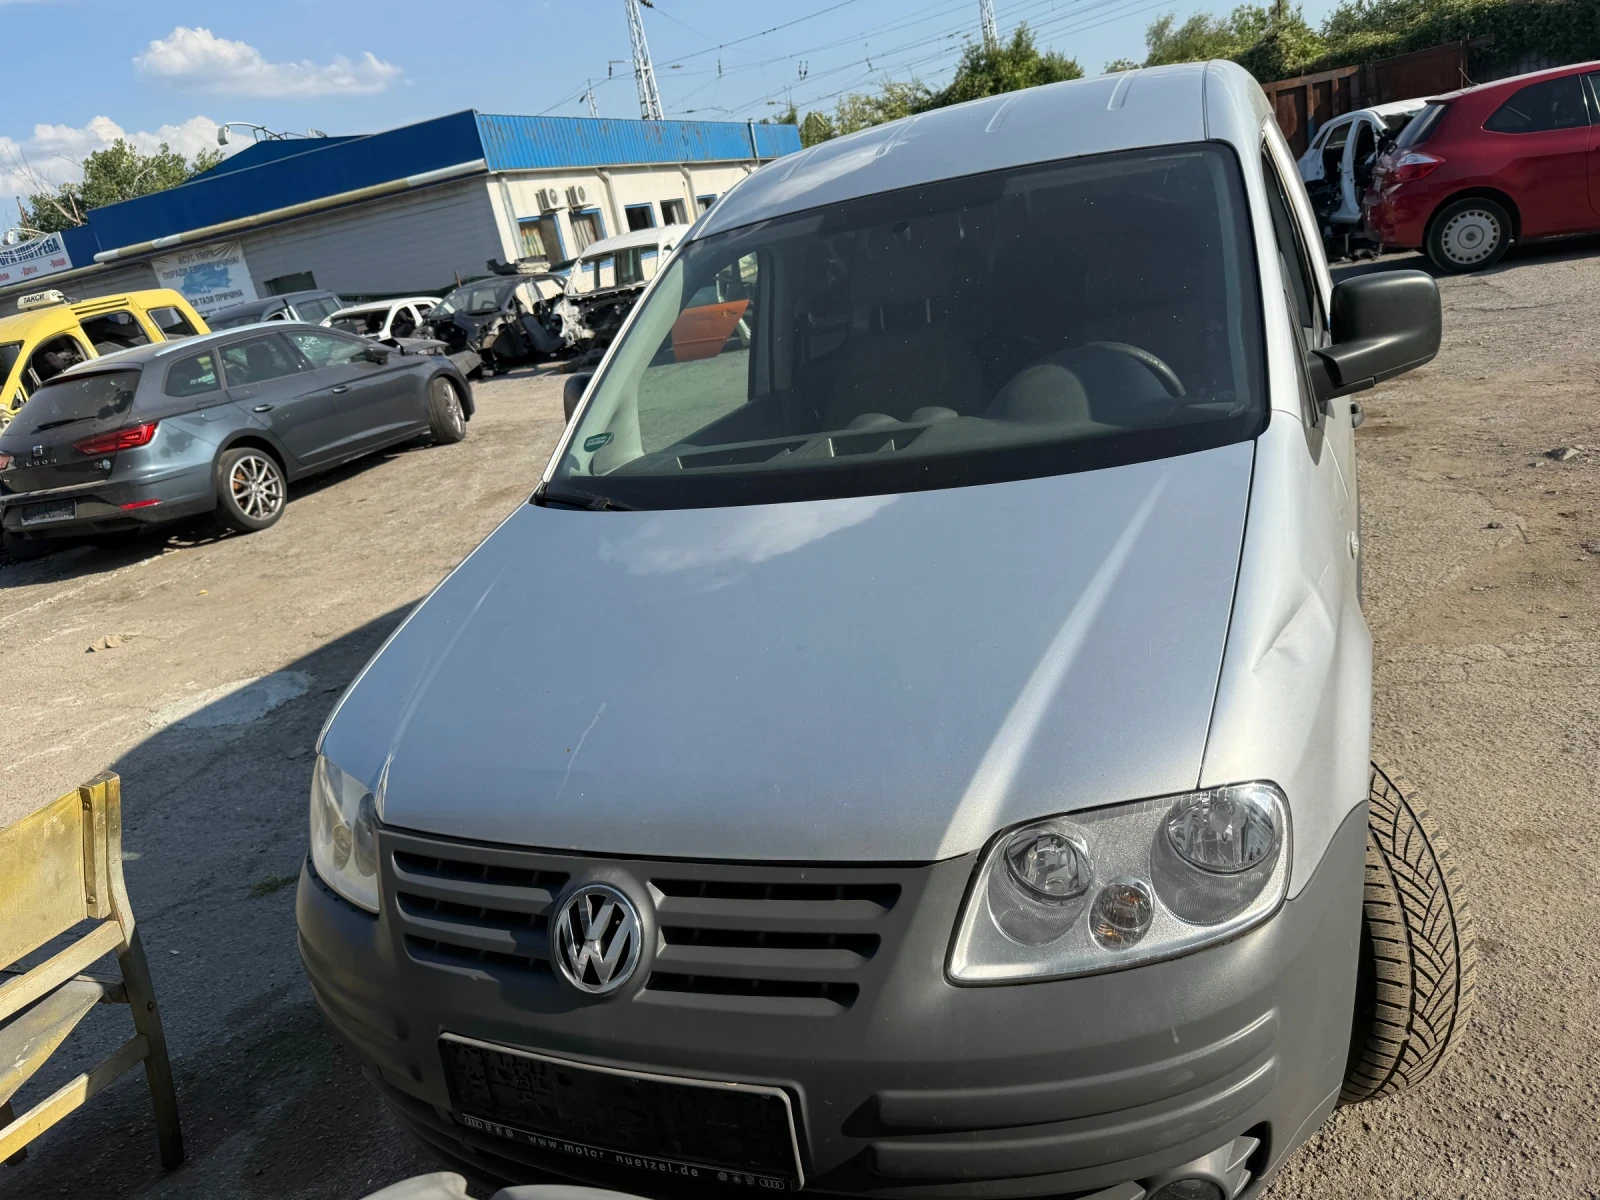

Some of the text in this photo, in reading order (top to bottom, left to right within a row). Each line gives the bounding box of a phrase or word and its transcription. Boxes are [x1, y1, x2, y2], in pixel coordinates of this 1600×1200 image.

[15, 237, 61, 262] УПОТРЕБА
[177, 253, 195, 264] ИСУС
[162, 267, 188, 280] ПОРАДИ
[23, 293, 45, 304] ТАКСИ
[199, 294, 215, 305] ТАЗИ
[215, 289, 244, 302] ПРИЧИНА
